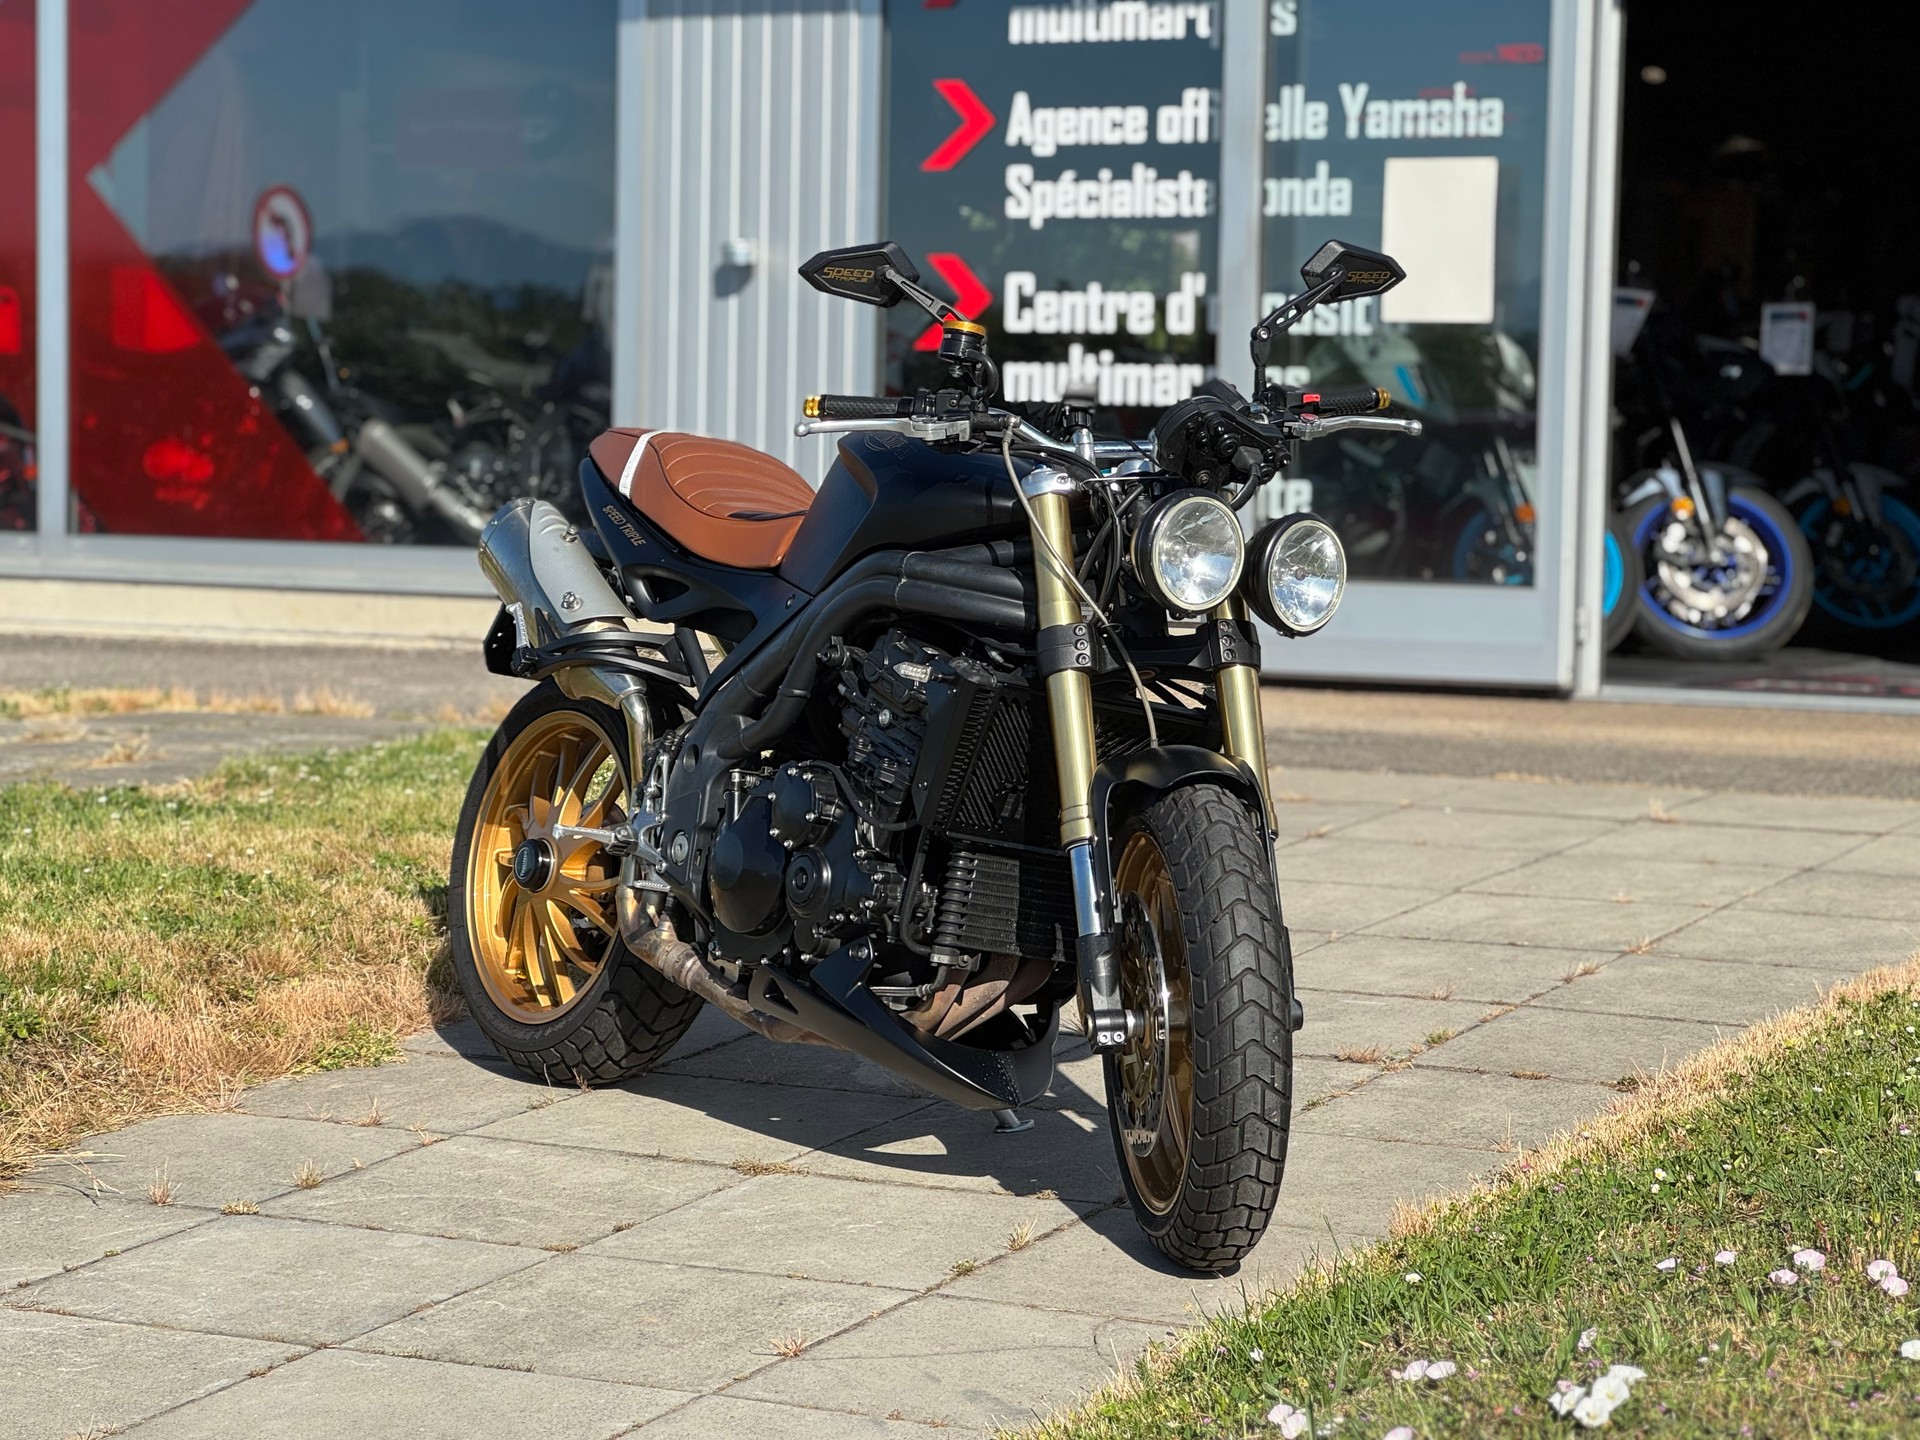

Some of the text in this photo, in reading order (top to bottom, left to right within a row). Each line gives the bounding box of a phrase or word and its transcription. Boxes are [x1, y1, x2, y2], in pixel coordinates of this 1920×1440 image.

[1005, 91, 1148, 157] Agence
[1338, 81, 1504, 139] Yamaha
[1005, 160, 1353, 230] Spécialiste onda
[821, 266, 875, 279] SPEED
[1346, 271, 1391, 282] SPEED
[1003, 271, 1155, 335] Centre
[602, 504, 647, 547] SPEED TRIPLE
